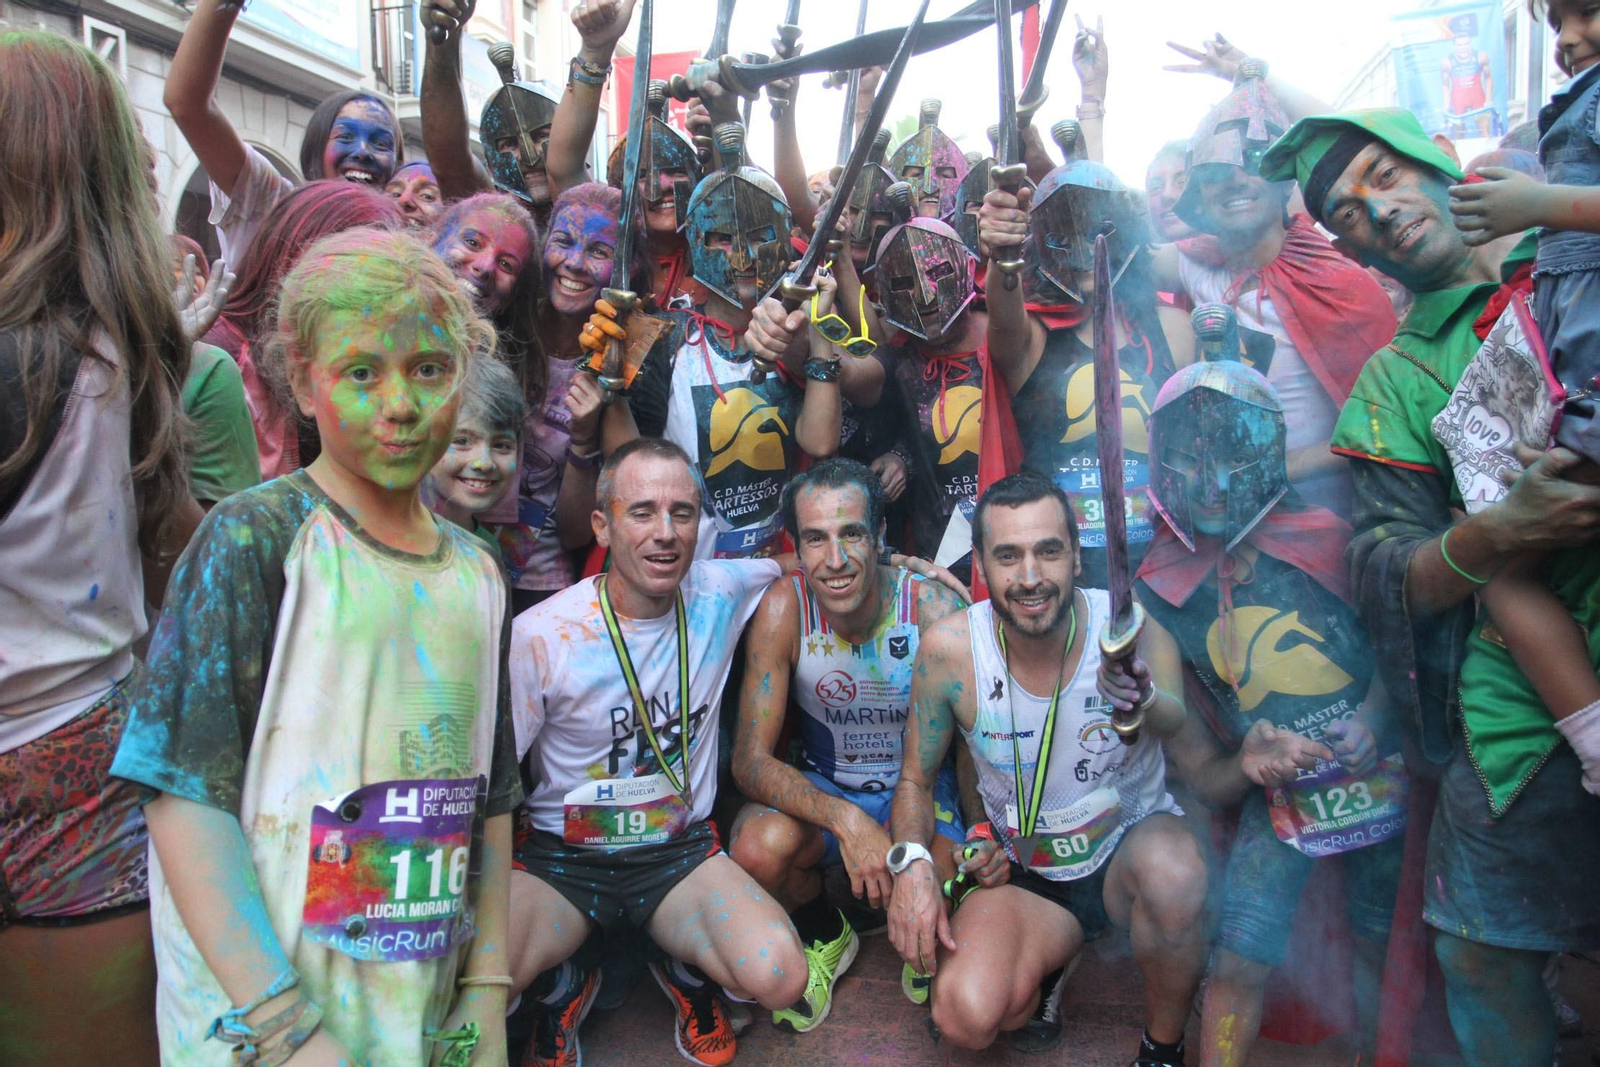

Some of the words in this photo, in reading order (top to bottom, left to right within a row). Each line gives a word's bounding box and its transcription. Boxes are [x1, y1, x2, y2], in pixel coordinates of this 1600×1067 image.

[1465, 415, 1501, 447] love
[1070, 457, 1080, 466] C.
[1082, 457, 1094, 467] D.
[951, 476, 961, 484] C.
[962, 475, 973, 483] D.
[714, 489, 723, 499] C.
[725, 487, 735, 497] D.
[714, 483, 778, 511] ARTESSOS
[726, 503, 760, 519] HUELVA
[1293, 699, 1349, 730] MÁSTER
[842, 732, 890, 741] ferrer
[843, 740, 894, 750] hotels
[615, 778, 660, 791] DIPUTACIÓN
[423, 785, 478, 802] DIPUTACIÓ
[615, 789, 627, 799] DE
[627, 787, 656, 798] HUELVA
[1309, 781, 1373, 820] 123
[422, 802, 439, 817] DE
[613, 810, 647, 835] 19
[1049, 819, 1060, 827] DE
[1061, 810, 1090, 826] HUELVA
[1300, 820, 1338, 835] VICTORIA
[584, 835, 610, 844] DANIEL
[610, 834, 641, 844] AGUIRRE
[641, 831, 669, 842] MORENO
[1051, 833, 1089, 858] 60
[389, 846, 468, 900] 116
[365, 903, 406, 919] LUCIA
[408, 900, 450, 917] MORAN
